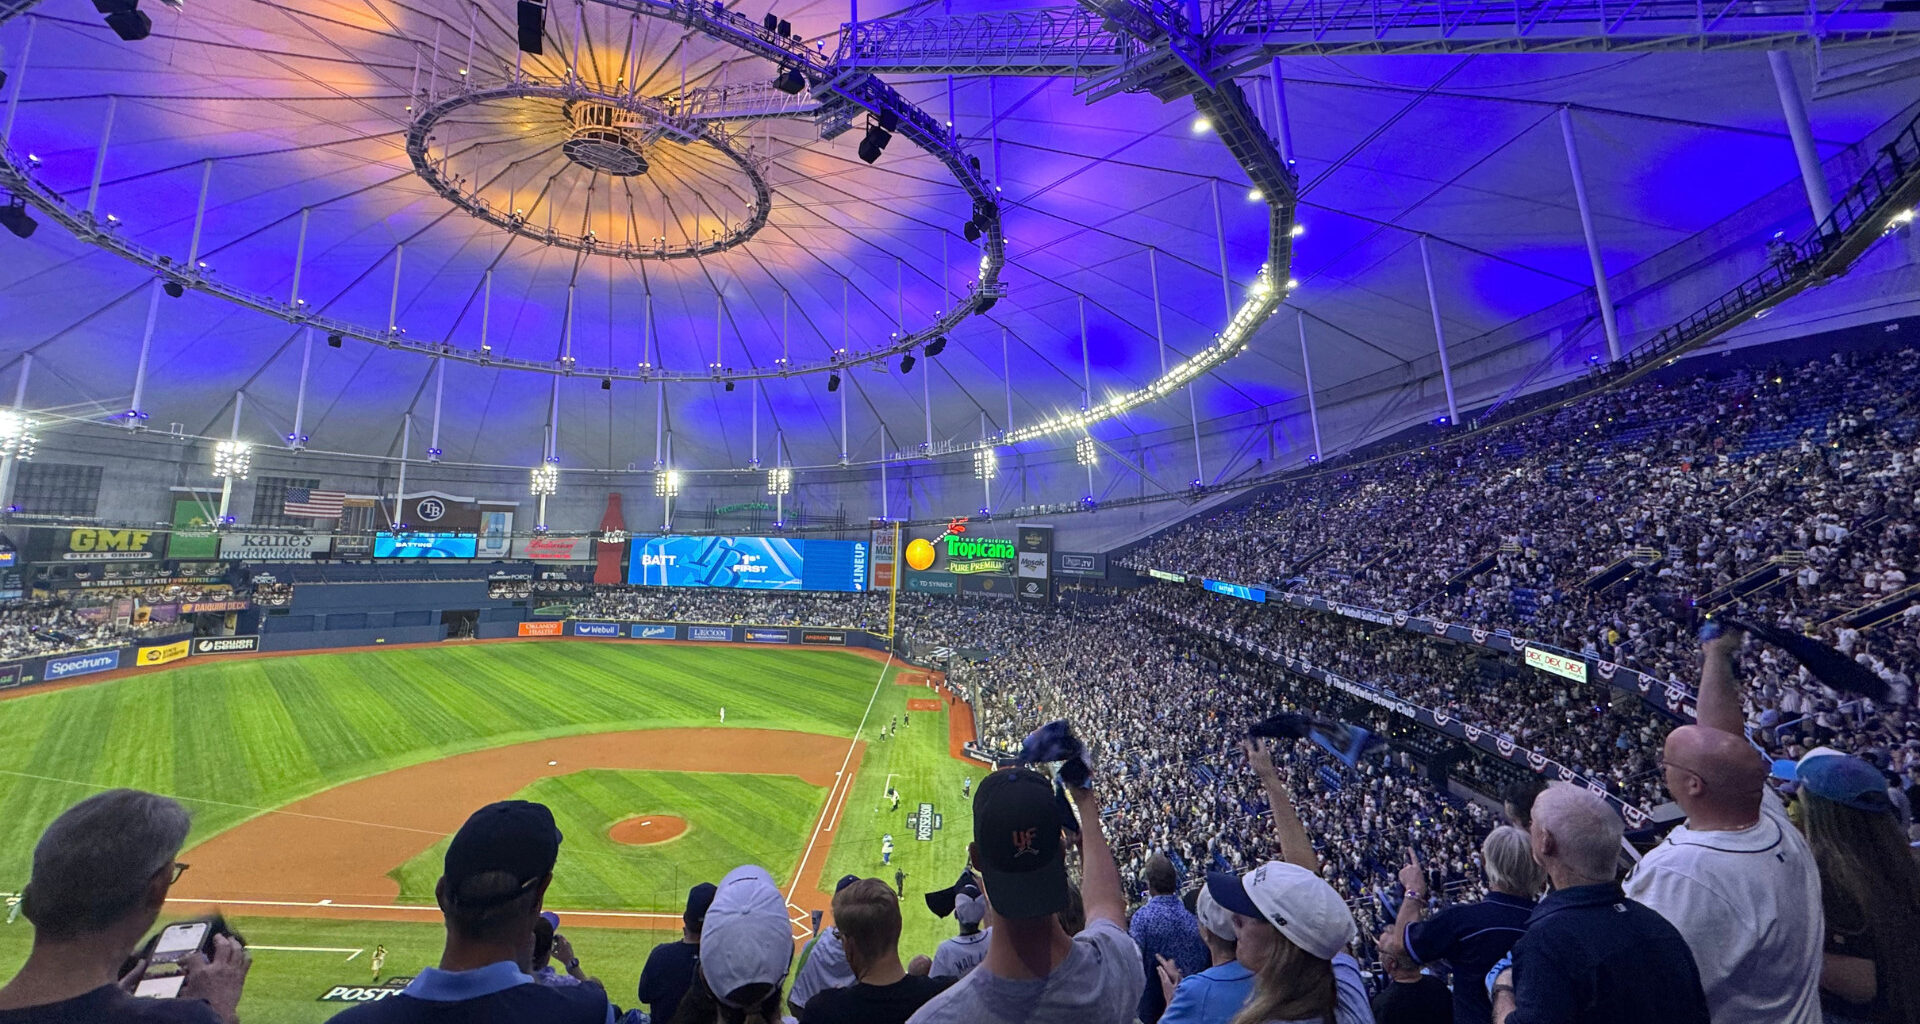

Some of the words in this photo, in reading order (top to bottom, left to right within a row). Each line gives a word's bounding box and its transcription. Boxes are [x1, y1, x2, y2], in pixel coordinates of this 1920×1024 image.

[423, 502, 440, 517] TB
[70, 529, 152, 551] GMF
[944, 535, 1015, 559] Tropicana
[732, 565, 768, 573] FIRST
[853, 543, 866, 583] LINEUP
[950, 562, 970, 571] PURE
[970, 561, 1005, 571] PREMIUM
[1021, 558, 1045, 567] Mosaic
[228, 601, 246, 610] DECK
[52, 656, 109, 674] Spectrum
[1526, 650, 1541, 661] DEX
[1545, 656, 1561, 667] DEX
[1565, 661, 1582, 674] DEX
[1332, 677, 1345, 690] The
[1372, 693, 1396, 712] Group
[1396, 702, 1416, 718] Club
[918, 803, 932, 841] POSTSEASON
